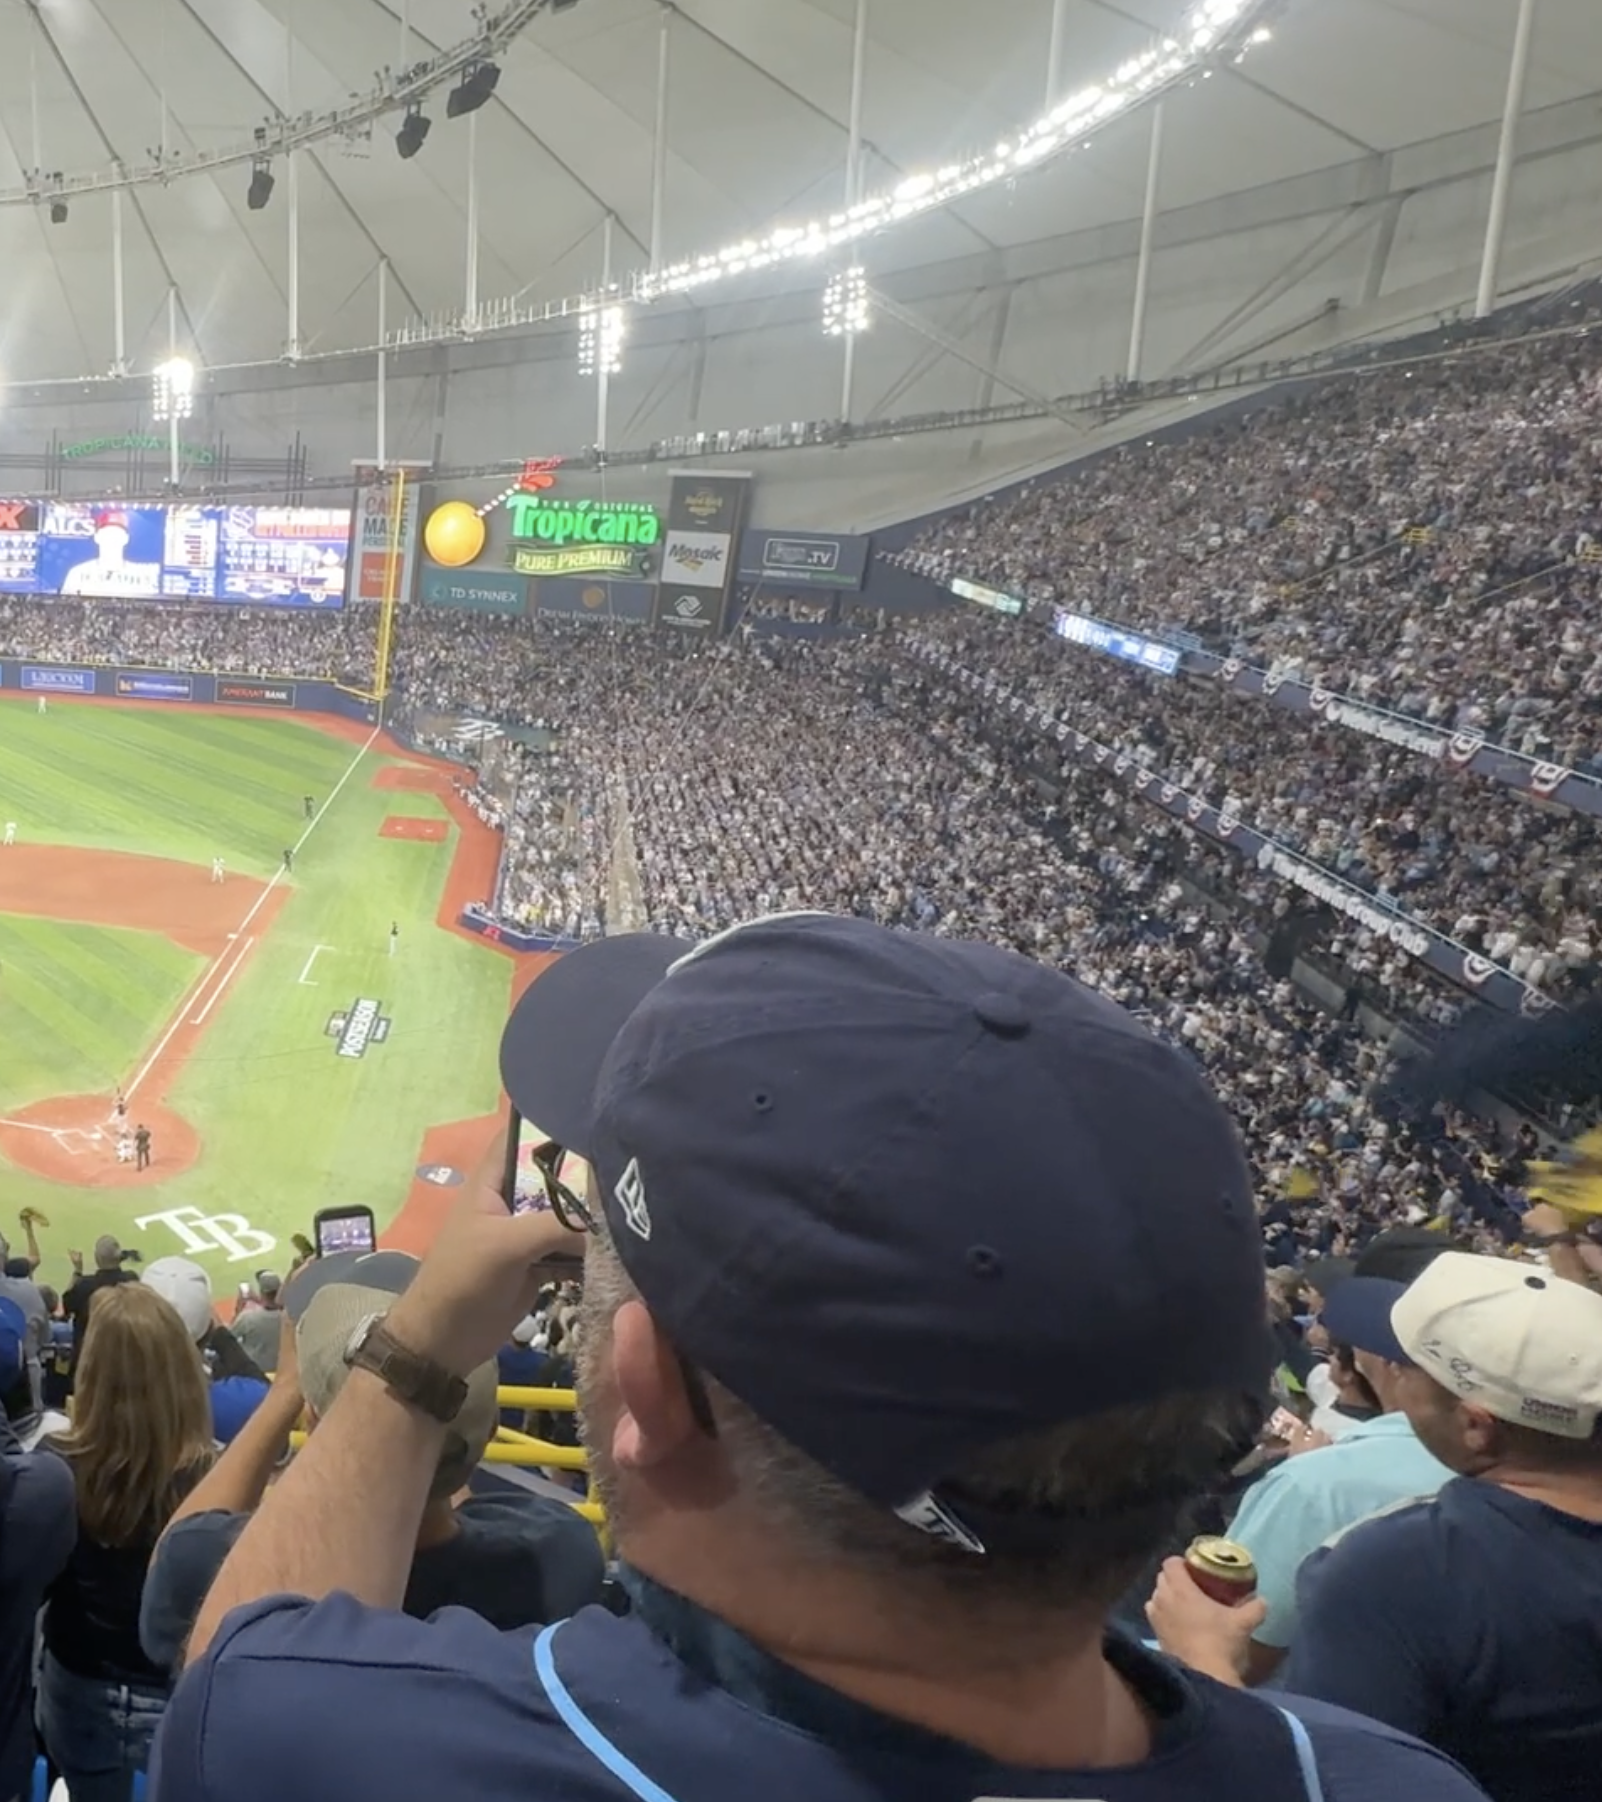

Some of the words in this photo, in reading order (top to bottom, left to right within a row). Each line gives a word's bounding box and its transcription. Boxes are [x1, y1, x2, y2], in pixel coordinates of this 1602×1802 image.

[43, 516, 96, 537] ALCS
[506, 495, 659, 545] Tropicana
[515, 551, 556, 570] PURE
[557, 549, 632, 570] PREMIUM
[669, 543, 724, 562] Mosaic
[451, 586, 465, 598] TD
[468, 588, 518, 603] SYNNEX
[265, 689, 288, 700] BANK
[339, 998, 378, 1058] POSTSEASON
[134, 1205, 277, 1263] TB
